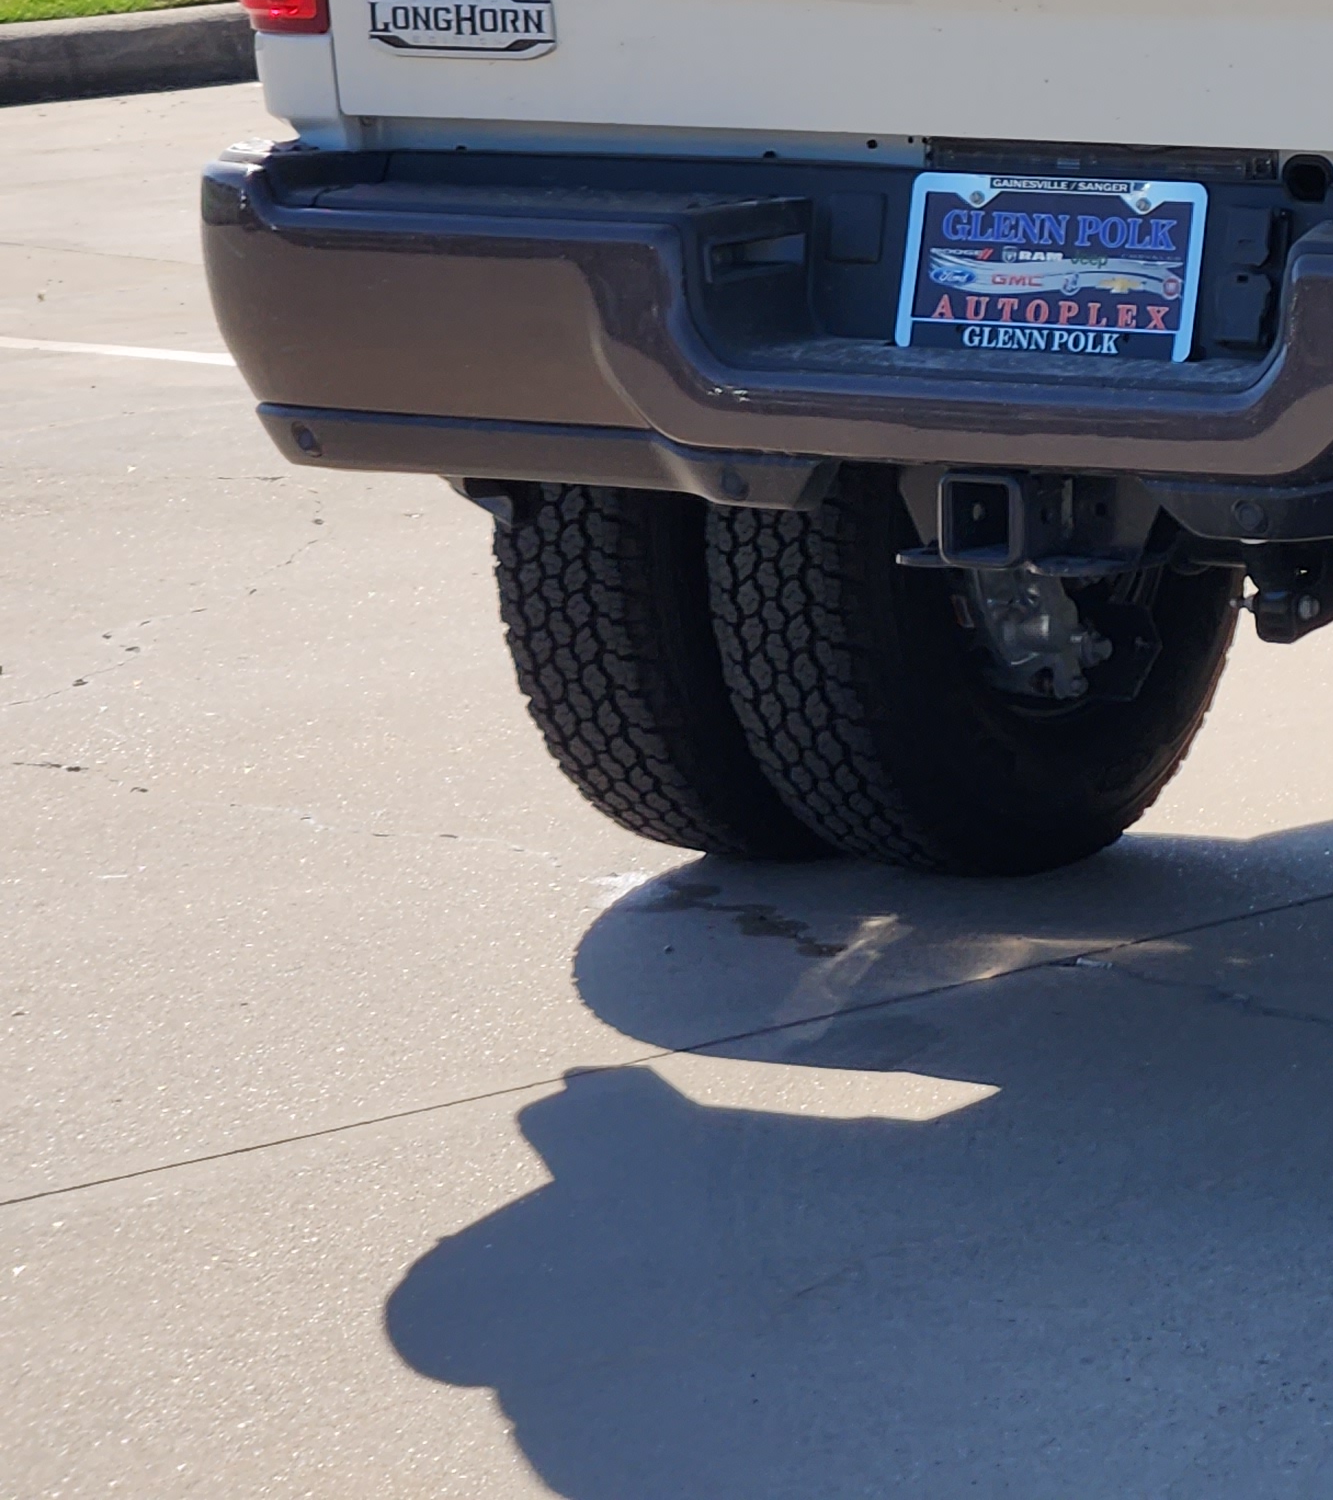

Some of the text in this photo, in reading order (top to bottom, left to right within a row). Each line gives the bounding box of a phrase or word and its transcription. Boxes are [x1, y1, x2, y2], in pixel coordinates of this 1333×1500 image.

[992, 178, 1068, 190] GAINESVILLE
[1077, 181, 1128, 192] SANGER
[942, 208, 1178, 251] GLENN POLK
[1018, 250, 1064, 261] RAM
[939, 269, 970, 283] Ford
[991, 273, 1045, 288] GMC
[931, 293, 1170, 330] AUTOPLEX
[962, 326, 1120, 354] GLENN POLK
